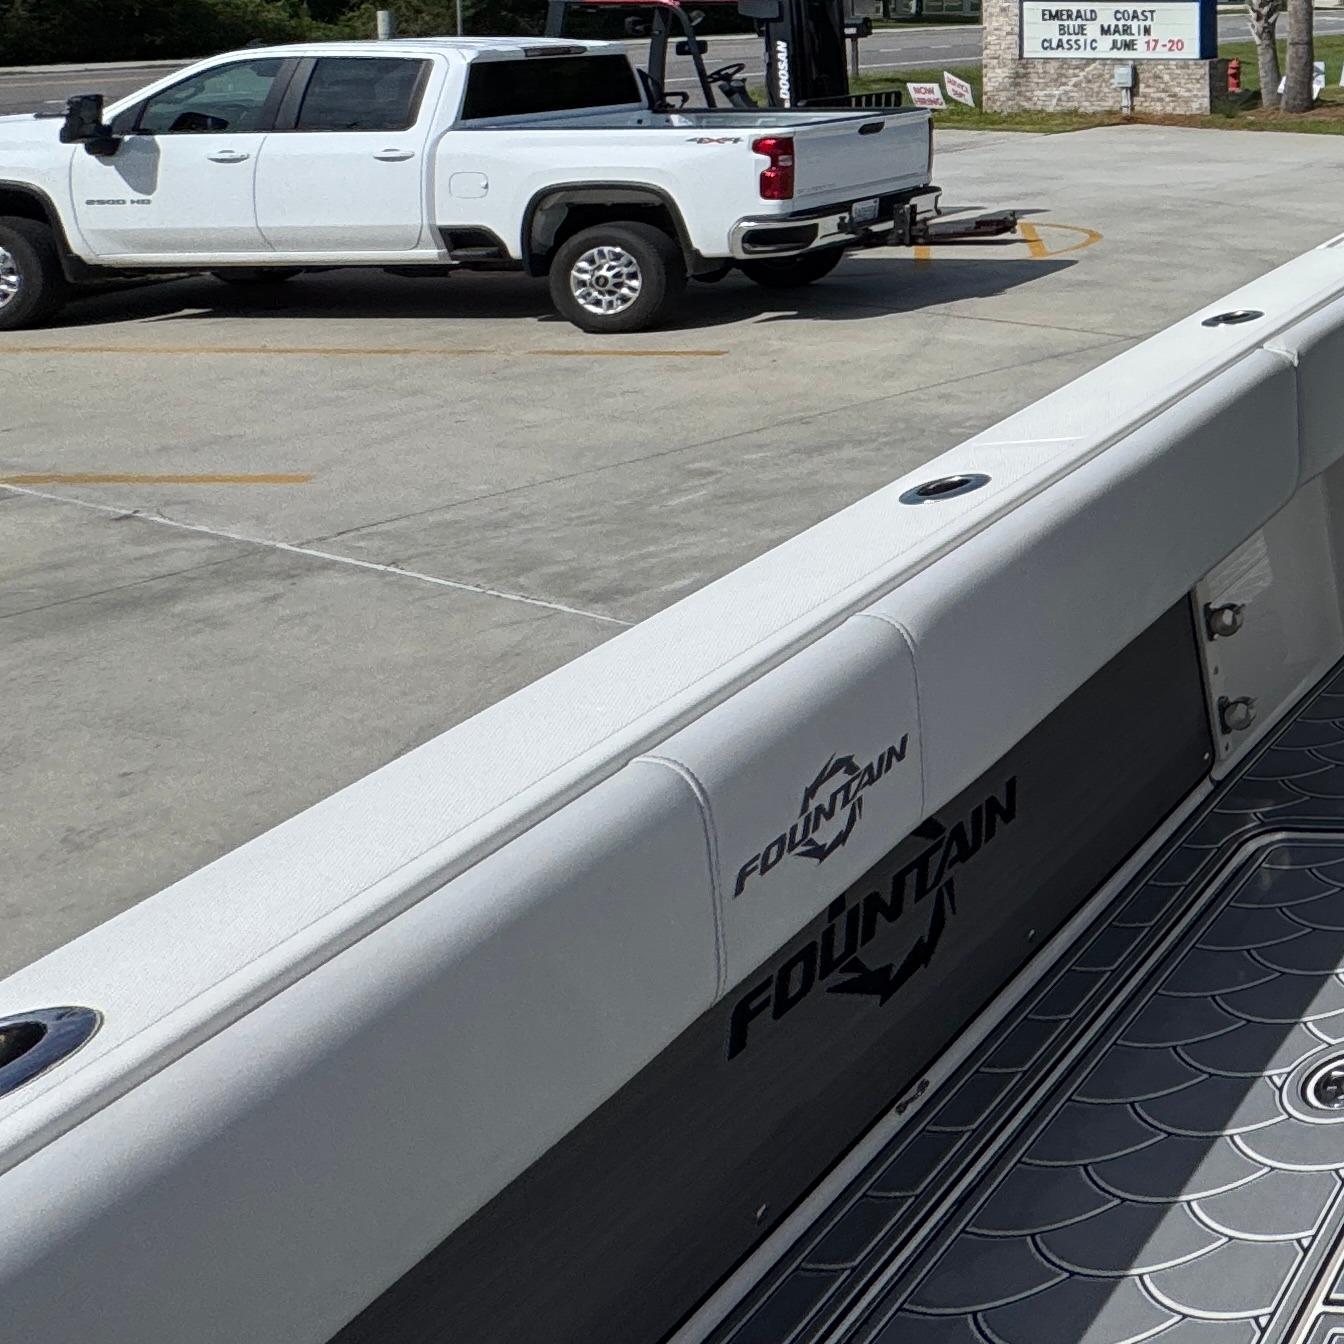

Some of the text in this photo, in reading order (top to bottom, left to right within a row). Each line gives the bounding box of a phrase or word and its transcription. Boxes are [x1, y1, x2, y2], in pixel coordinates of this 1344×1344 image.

[1041, 9, 1156, 22] EMERALD COAST
[1058, 23, 1152, 36] BLUE MARLIN
[1041, 38, 1185, 52] CLASSIC JUNE 17-20
[776, 40, 790, 99] DOOSAN
[733, 733, 909, 899] FOUNTAIN
[728, 776, 1017, 1062] FOUNTAIN
